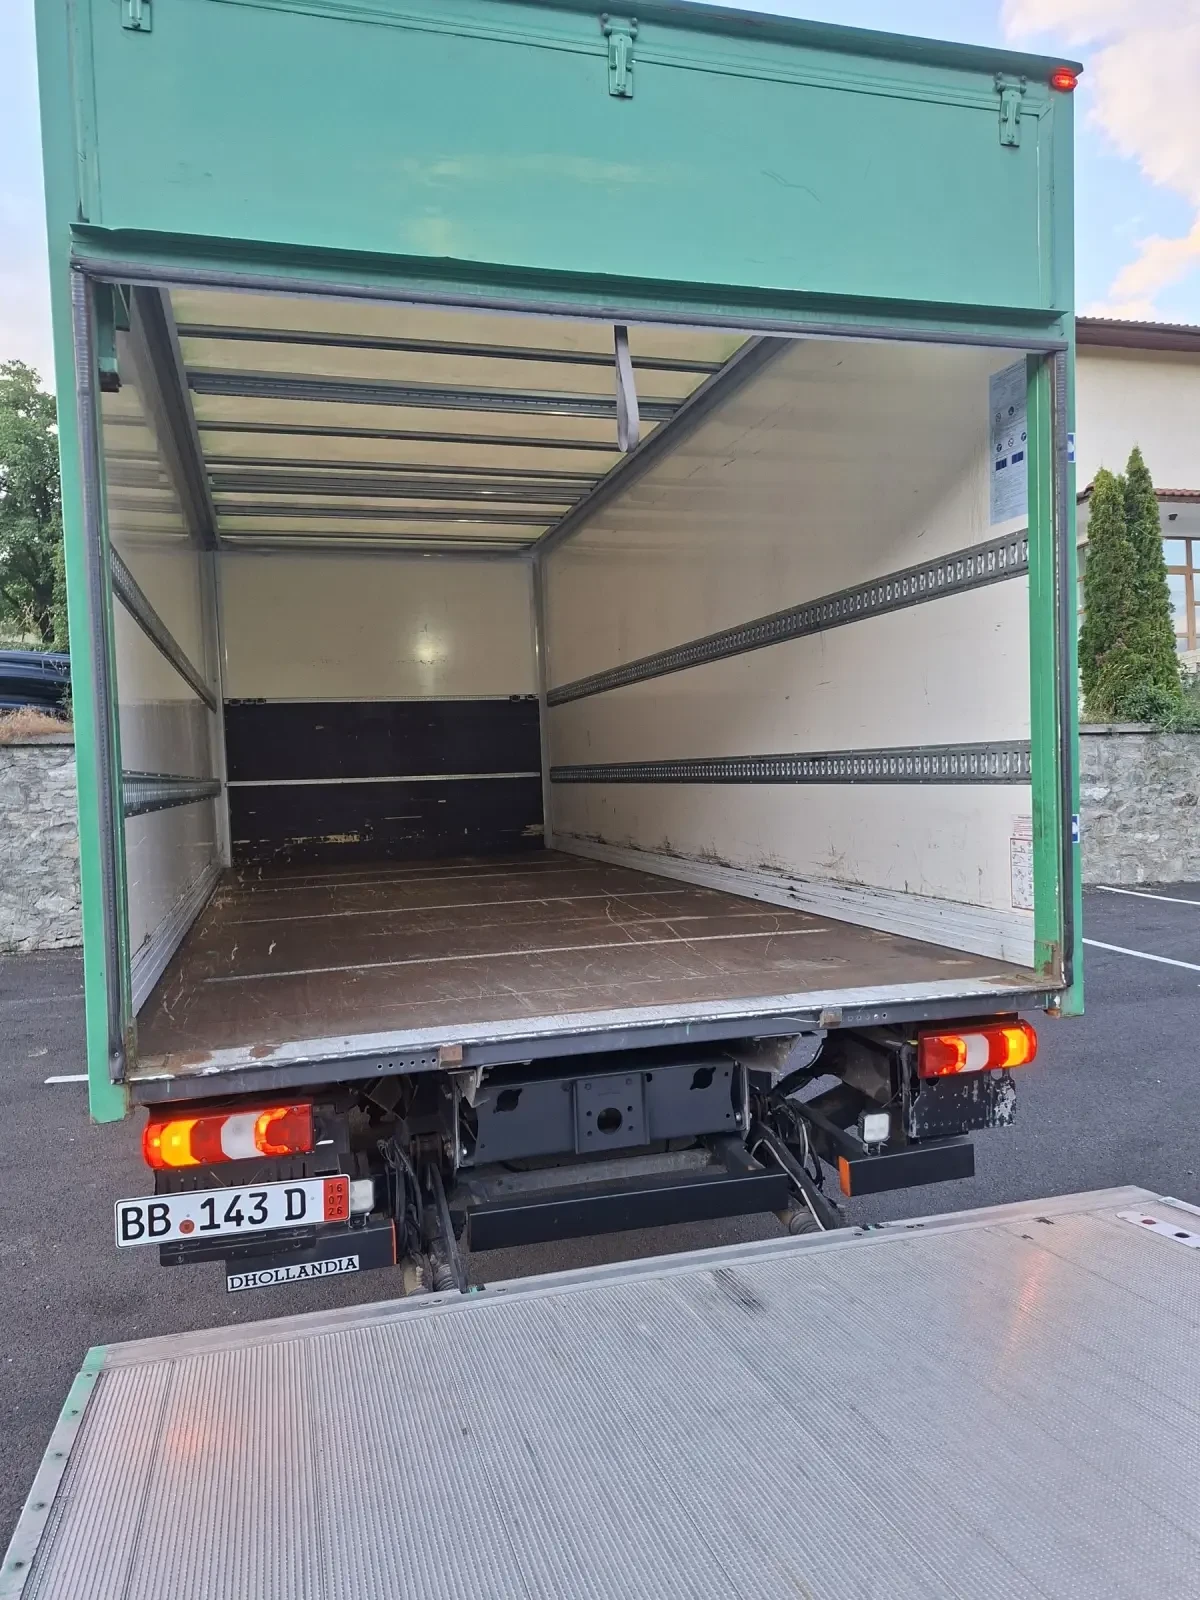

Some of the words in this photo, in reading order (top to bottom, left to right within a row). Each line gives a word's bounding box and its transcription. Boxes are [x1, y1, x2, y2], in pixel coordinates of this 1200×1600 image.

[121, 1203, 172, 1241] BB
[199, 1192, 269, 1231] 143
[284, 1187, 307, 1221] D
[230, 1257, 357, 1290] DHOLLANDIA
